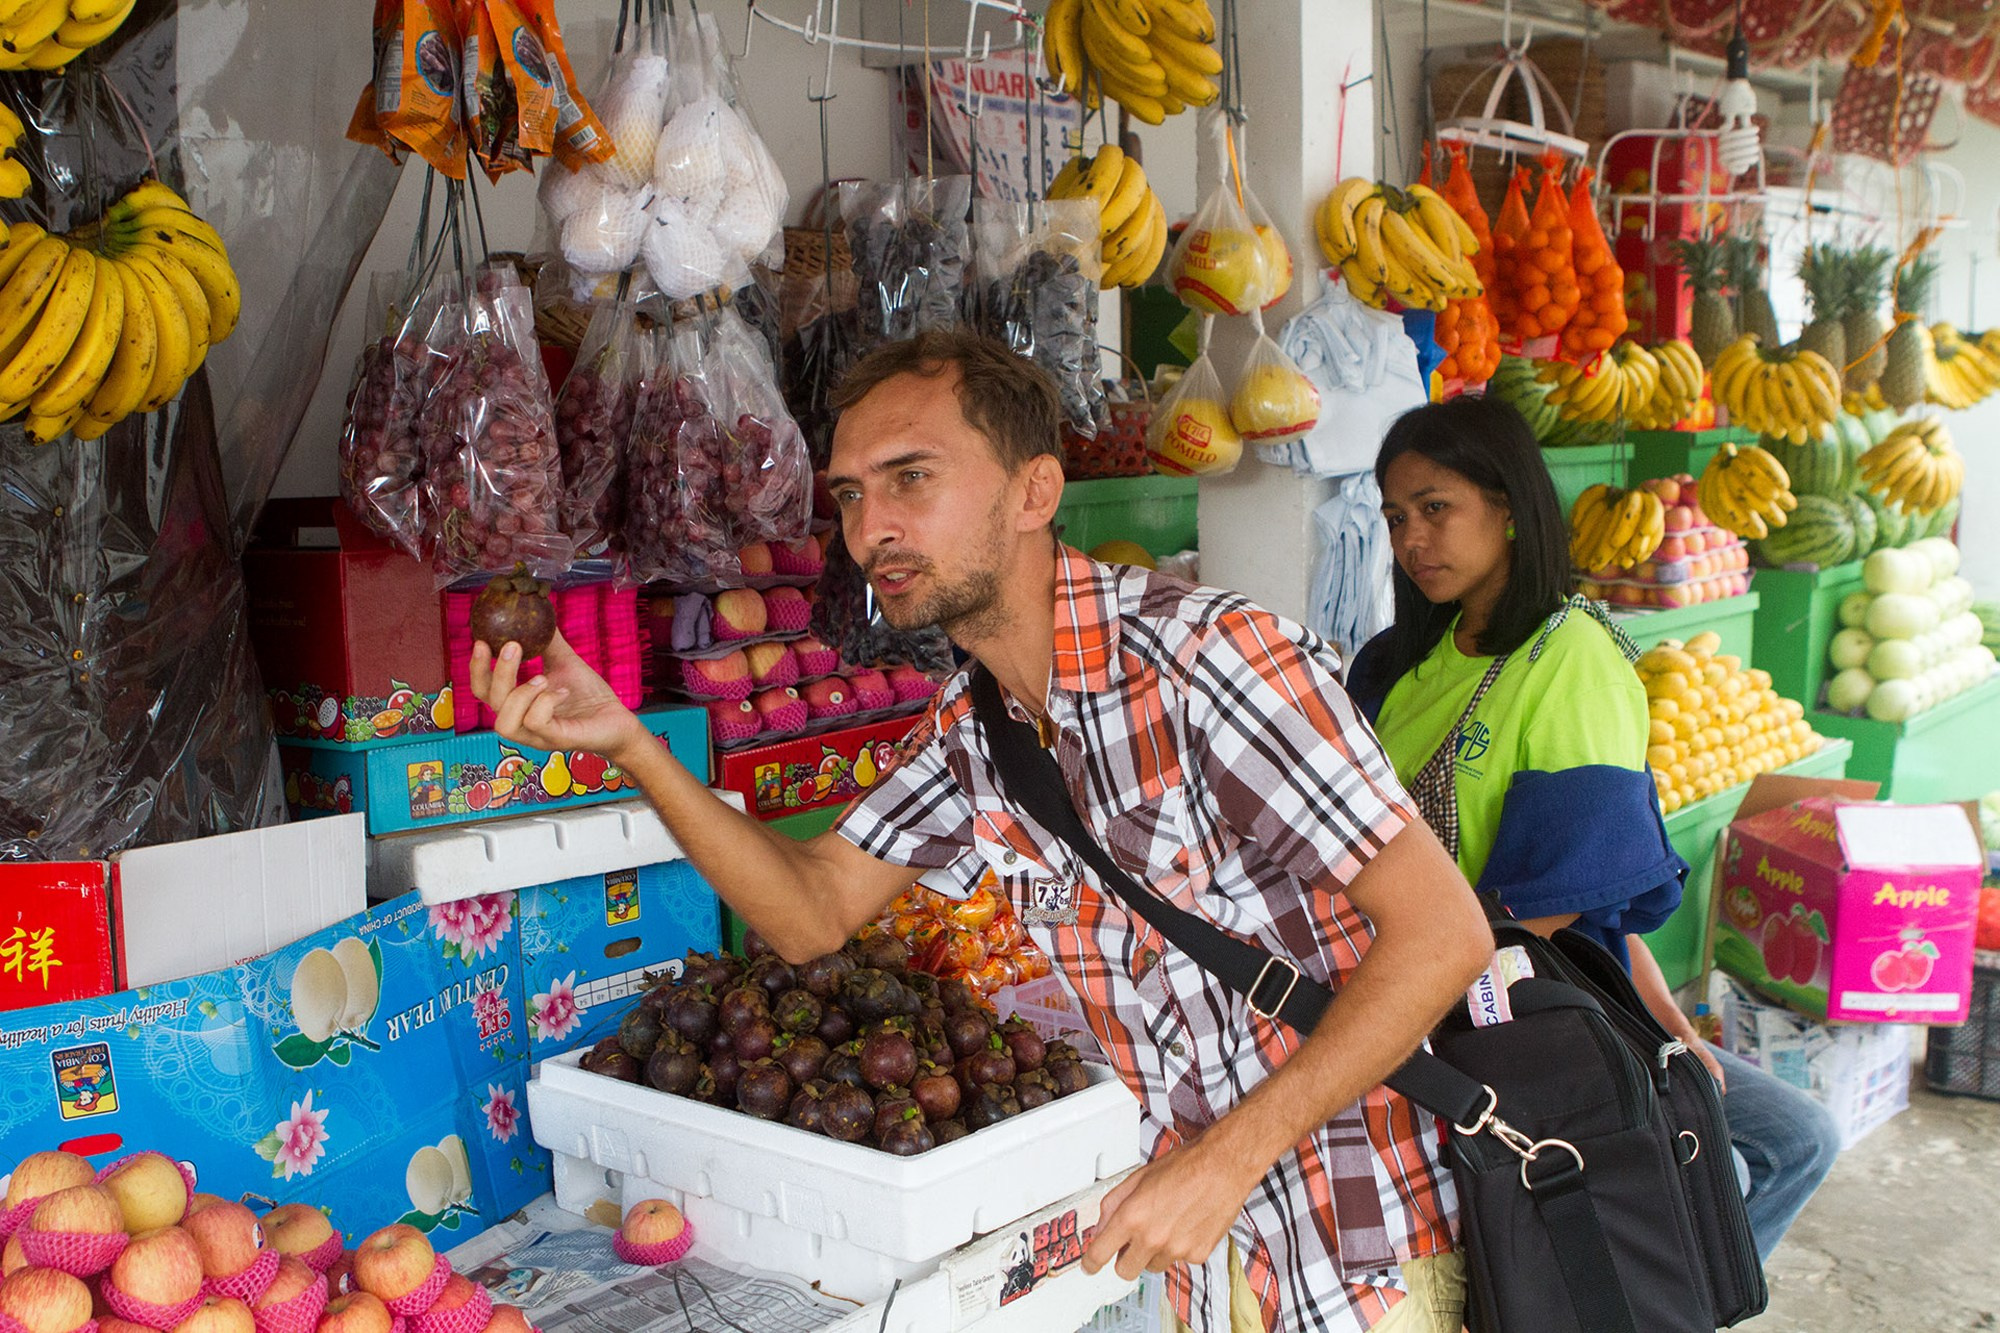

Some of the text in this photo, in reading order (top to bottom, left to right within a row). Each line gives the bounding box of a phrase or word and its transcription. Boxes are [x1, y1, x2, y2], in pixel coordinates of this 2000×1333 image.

[952, 60, 1035, 99] JANUARY
[1165, 430, 1217, 464] POMELO
[1756, 855, 1805, 895] Apple
[1872, 881, 1950, 908] Apple
[358, 918, 381, 936] CHINA
[0, 926, 63, 991] 祥
[130, 999, 189, 1024] Healthy
[386, 963, 509, 1042] CENTURY PEAR
[1479, 974, 1499, 1026] CABIN
[51, 1024, 63, 1037] a
[66, 1016, 86, 1038] for
[90, 1007, 127, 1033] fruits
[479, 1008, 511, 1039] CFT
[55, 1052, 106, 1068] COLMBIA
[1033, 1208, 1077, 1253] BIG
